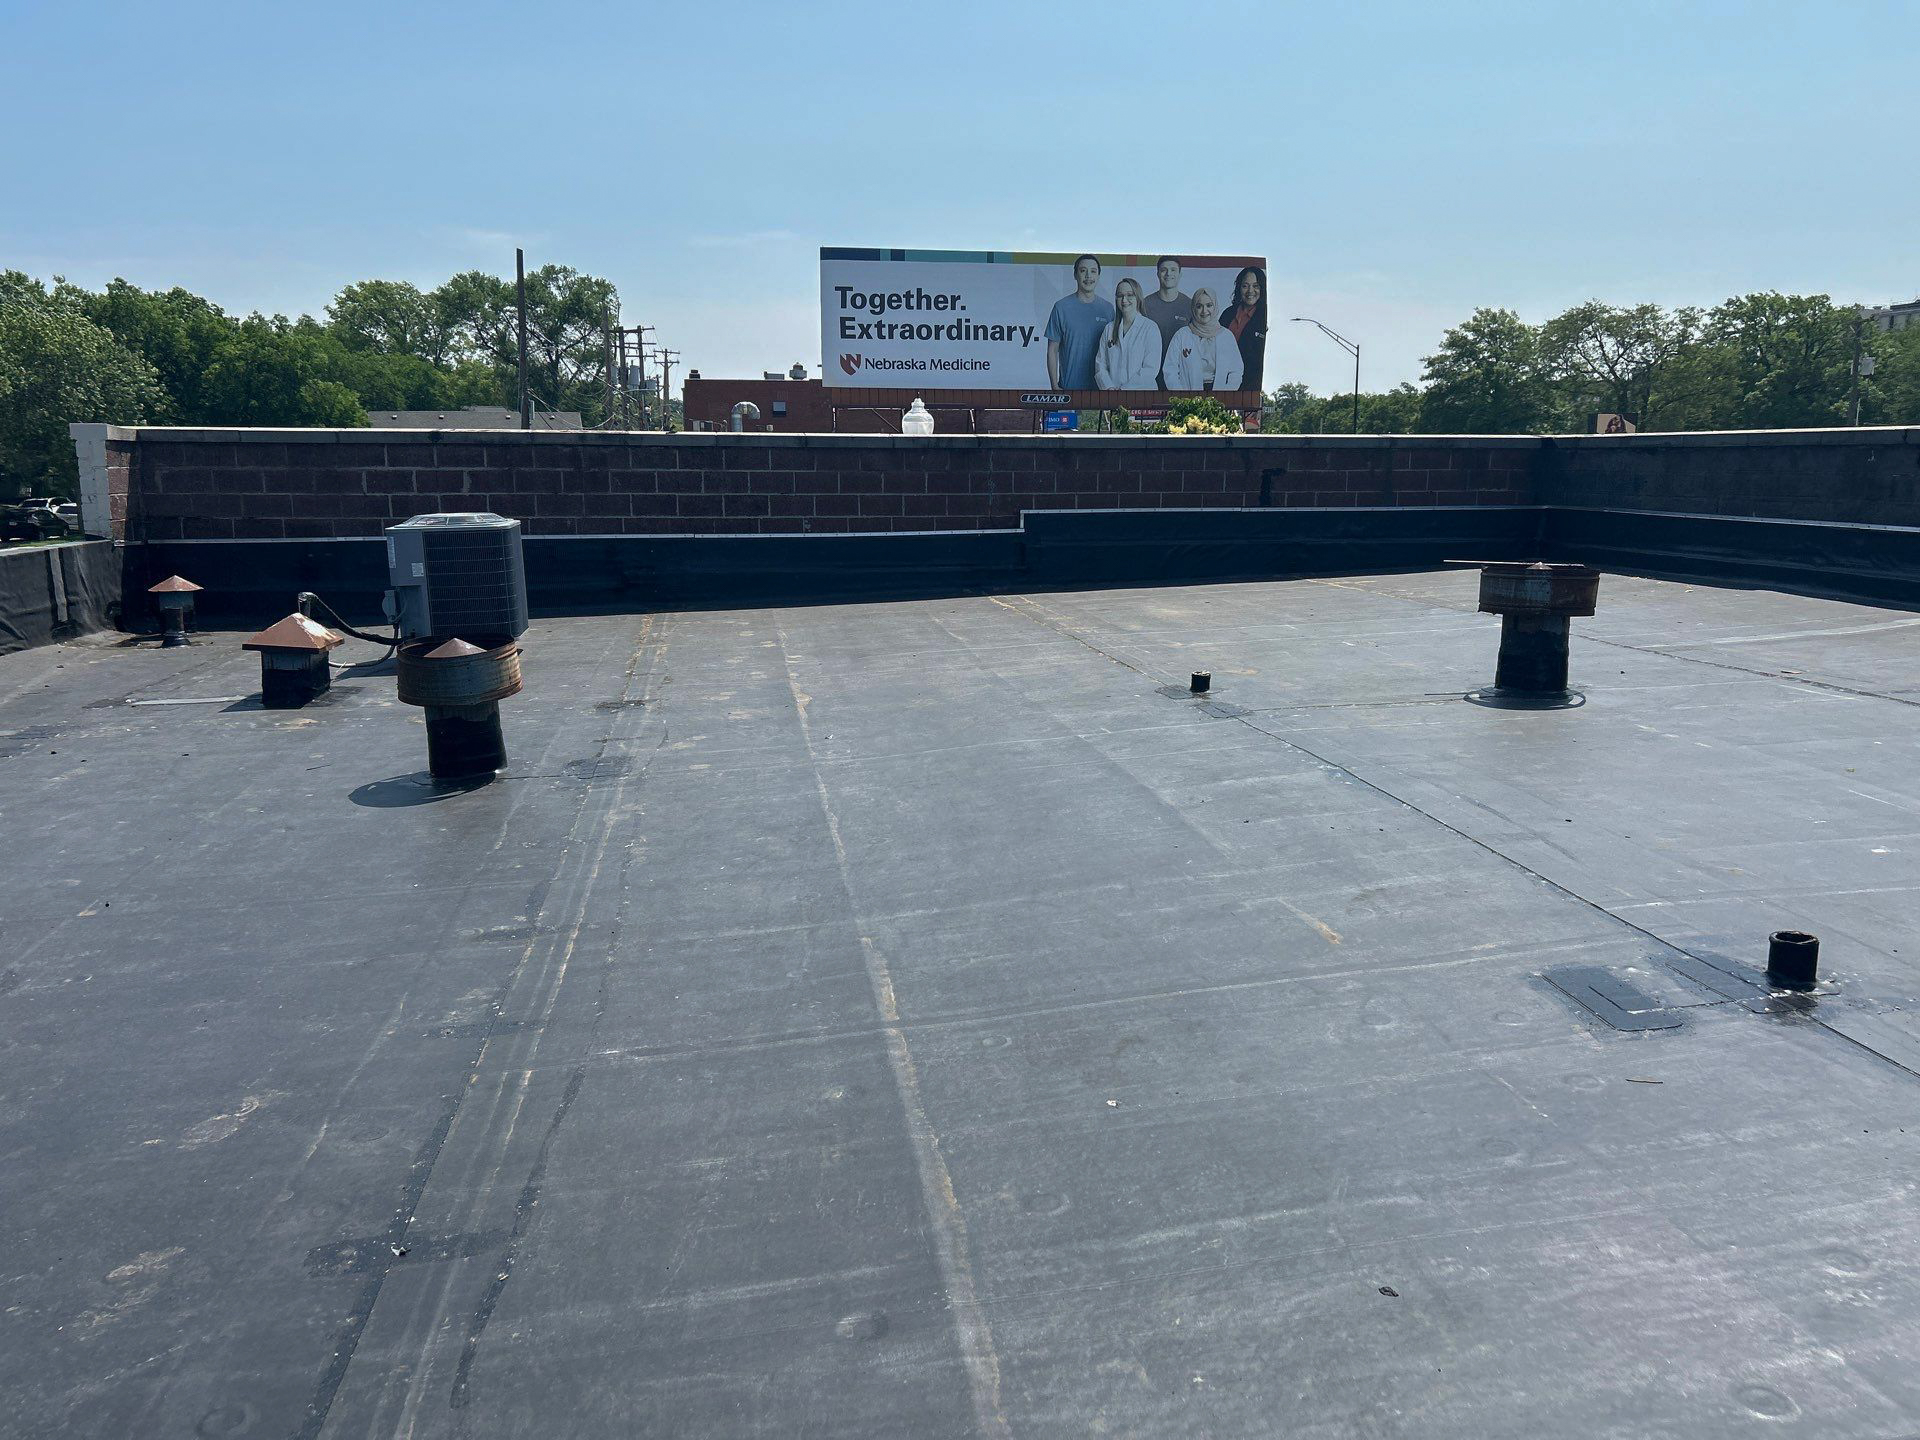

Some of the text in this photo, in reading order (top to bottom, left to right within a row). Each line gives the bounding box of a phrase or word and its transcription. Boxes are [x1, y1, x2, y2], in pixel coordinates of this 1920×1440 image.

[835, 286, 966, 315] Together.
[839, 316, 1039, 347] Extraordinary.
[865, 357, 926, 370] Nebraska
[929, 358, 990, 371] Medicine
